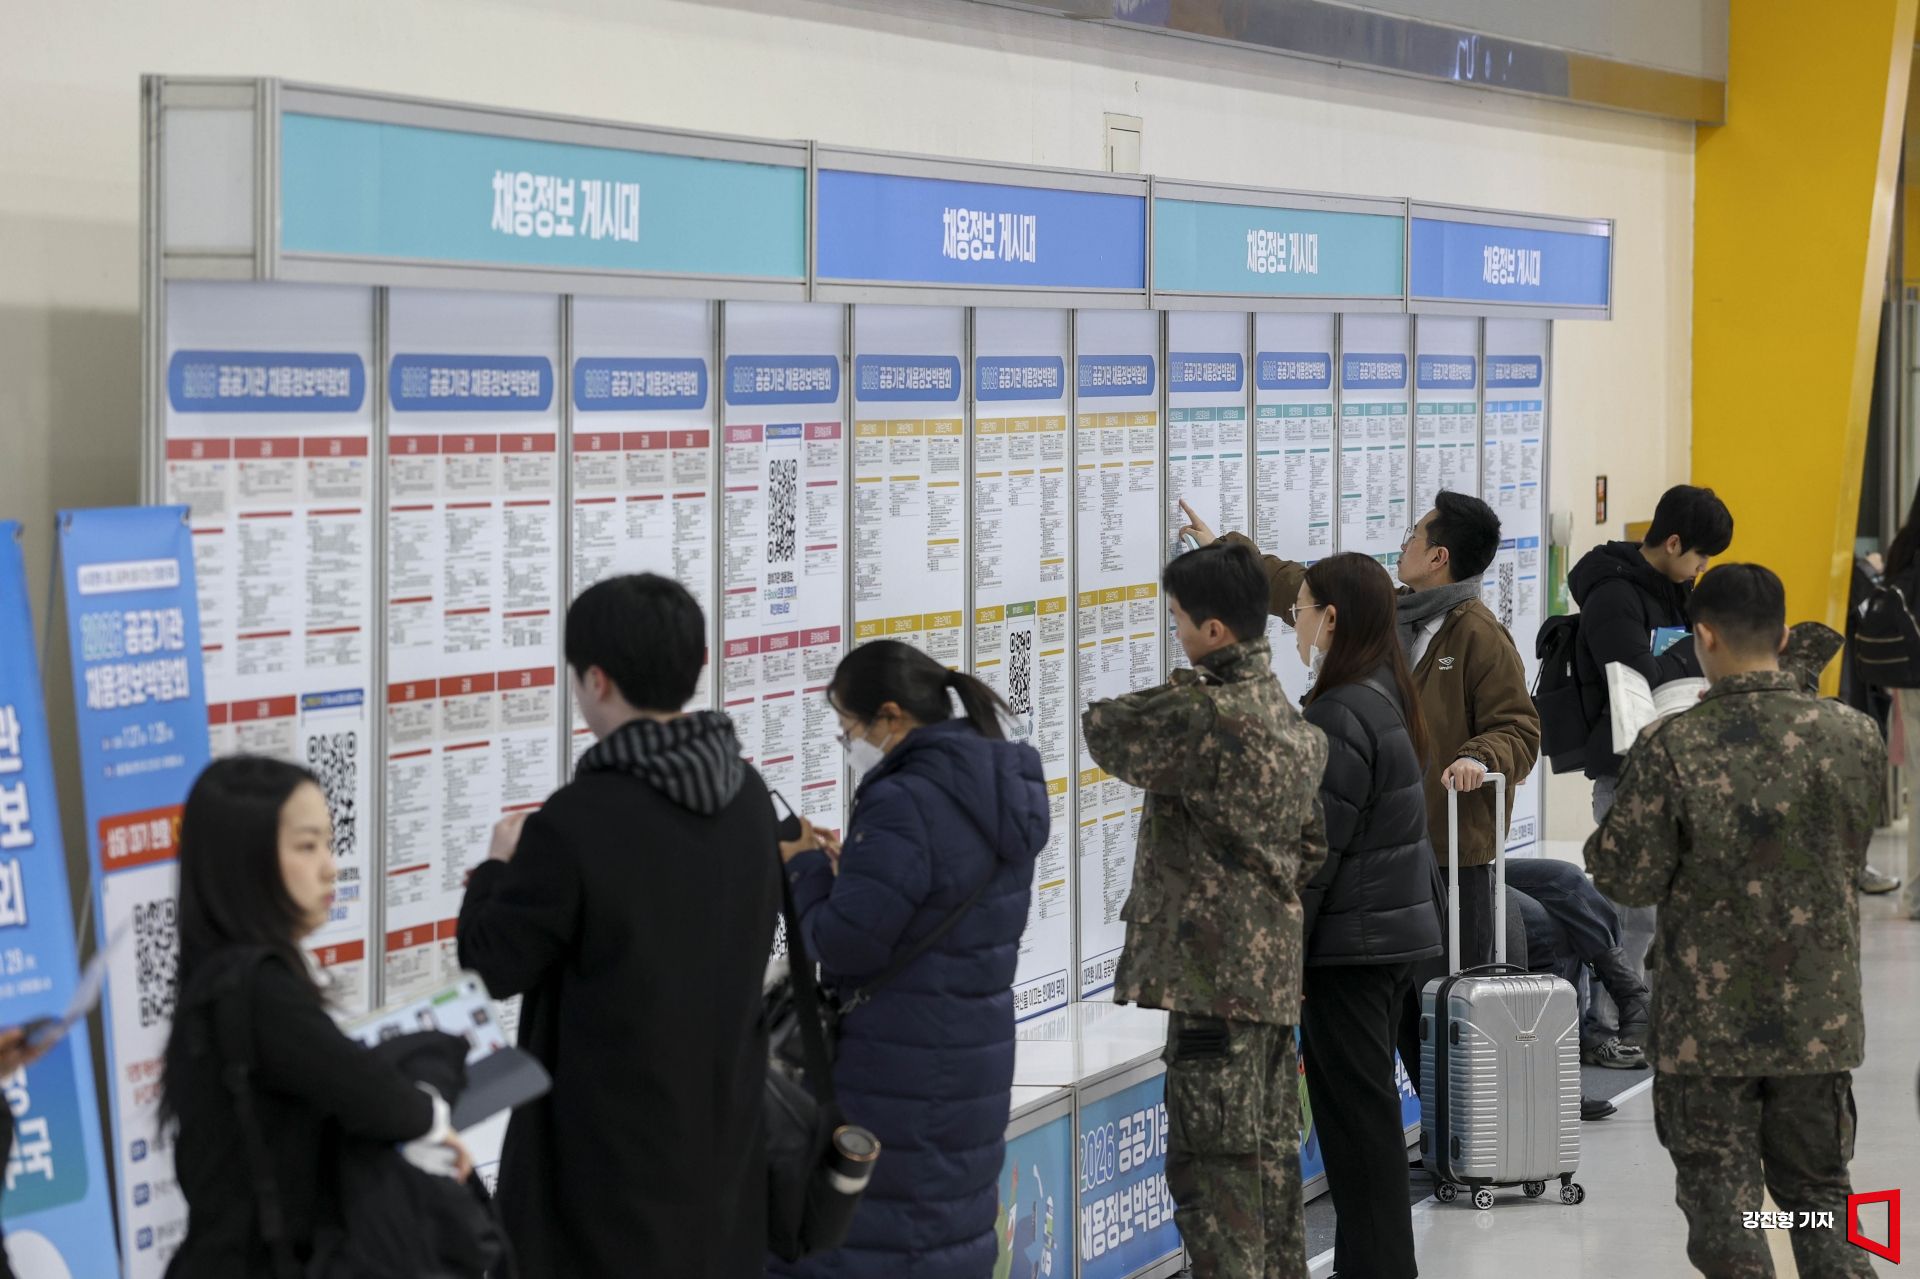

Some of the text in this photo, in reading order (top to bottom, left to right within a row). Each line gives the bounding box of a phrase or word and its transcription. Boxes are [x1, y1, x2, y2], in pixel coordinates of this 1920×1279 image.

[491, 170, 641, 242] 채용정보 게시대
[943, 207, 1036, 263] 채용정보 게시대
[1247, 229, 1318, 274] 채용정보 게시대
[1483, 245, 1541, 286] 채용정보 게시대
[756, 367, 785, 391] 공공기관
[880, 366, 905, 389] 공공기관
[999, 367, 1021, 388] 공공기관
[124, 607, 184, 655] 공공기관
[1056, 978, 1065, 998] 무대
[1081, 1122, 1115, 1192] 2026
